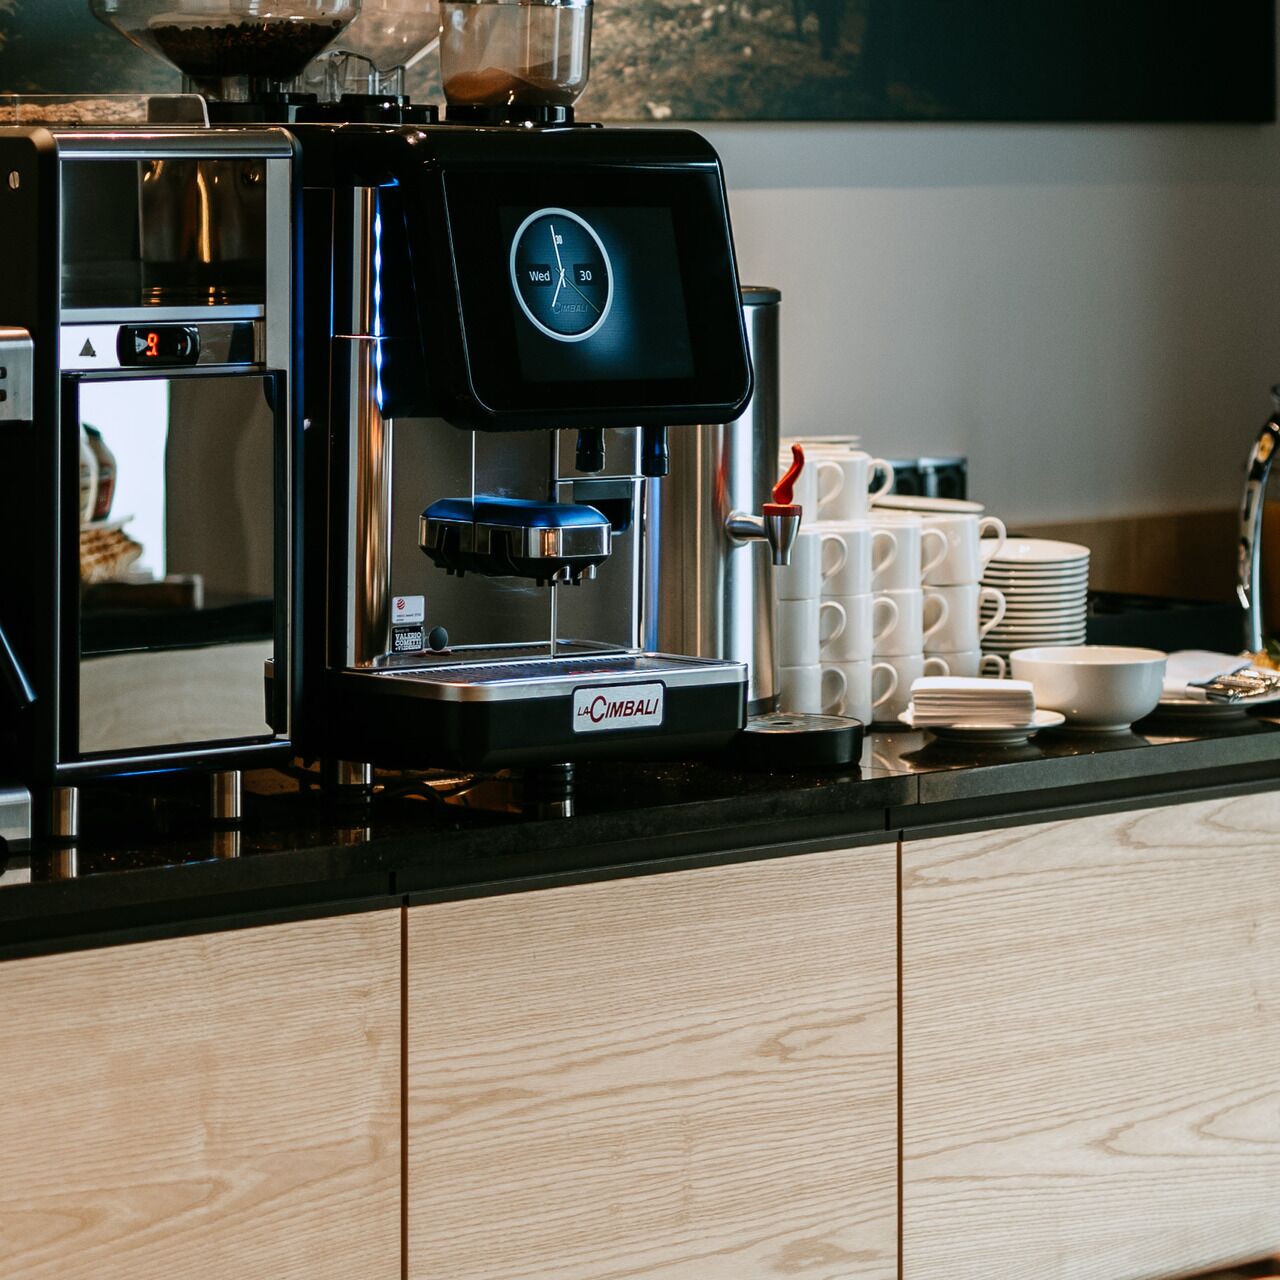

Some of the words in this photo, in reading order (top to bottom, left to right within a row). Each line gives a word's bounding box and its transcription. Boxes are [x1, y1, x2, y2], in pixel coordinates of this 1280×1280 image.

[529, 270, 551, 282] Wed
[579, 270, 593, 281] 30
[577, 706, 591, 717] LA
[590, 695, 660, 723] CIMBALI
